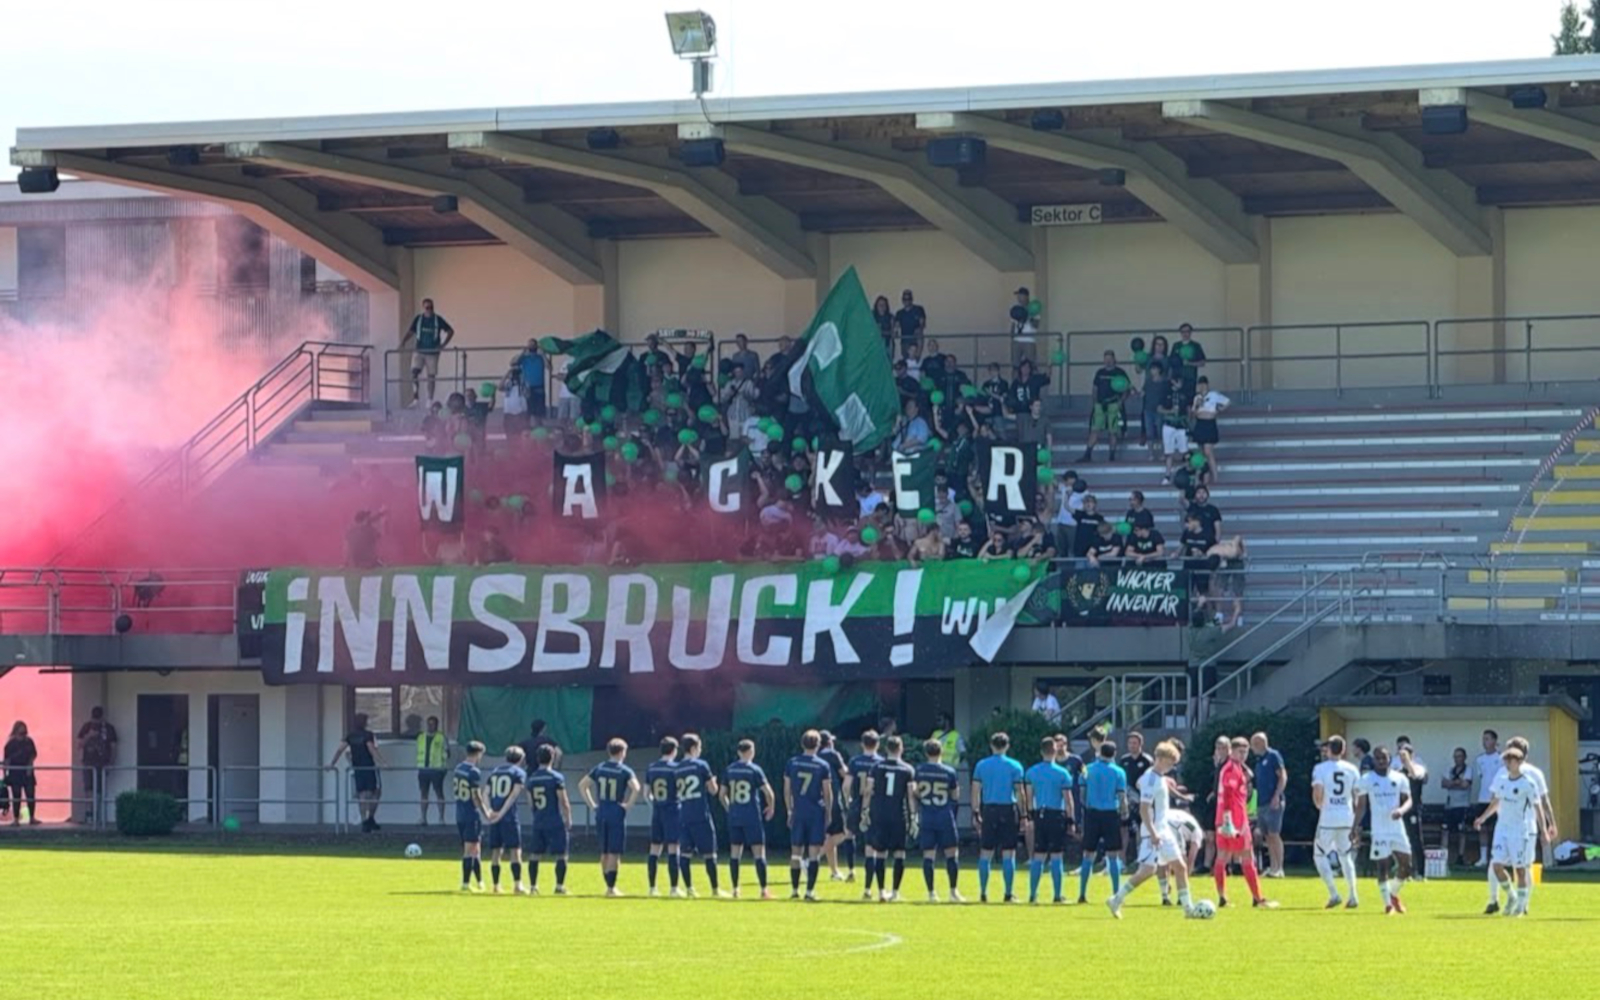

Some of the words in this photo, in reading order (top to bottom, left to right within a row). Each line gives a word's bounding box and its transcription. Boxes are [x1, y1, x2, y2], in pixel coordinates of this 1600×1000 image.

[1033, 207, 1083, 223] Sektor
[1089, 205, 1100, 221] C
[1116, 568, 1176, 593] WACKER
[1105, 592, 1180, 618] INVENTAR
[490, 775, 512, 799] 10
[598, 777, 617, 801] 11
[676, 775, 701, 801] 22
[729, 780, 751, 804] 18
[797, 772, 813, 796] 7
[885, 772, 896, 797] 1
[918, 781, 949, 807] 25
[1333, 772, 1345, 796] 5
[533, 786, 547, 810] 5
